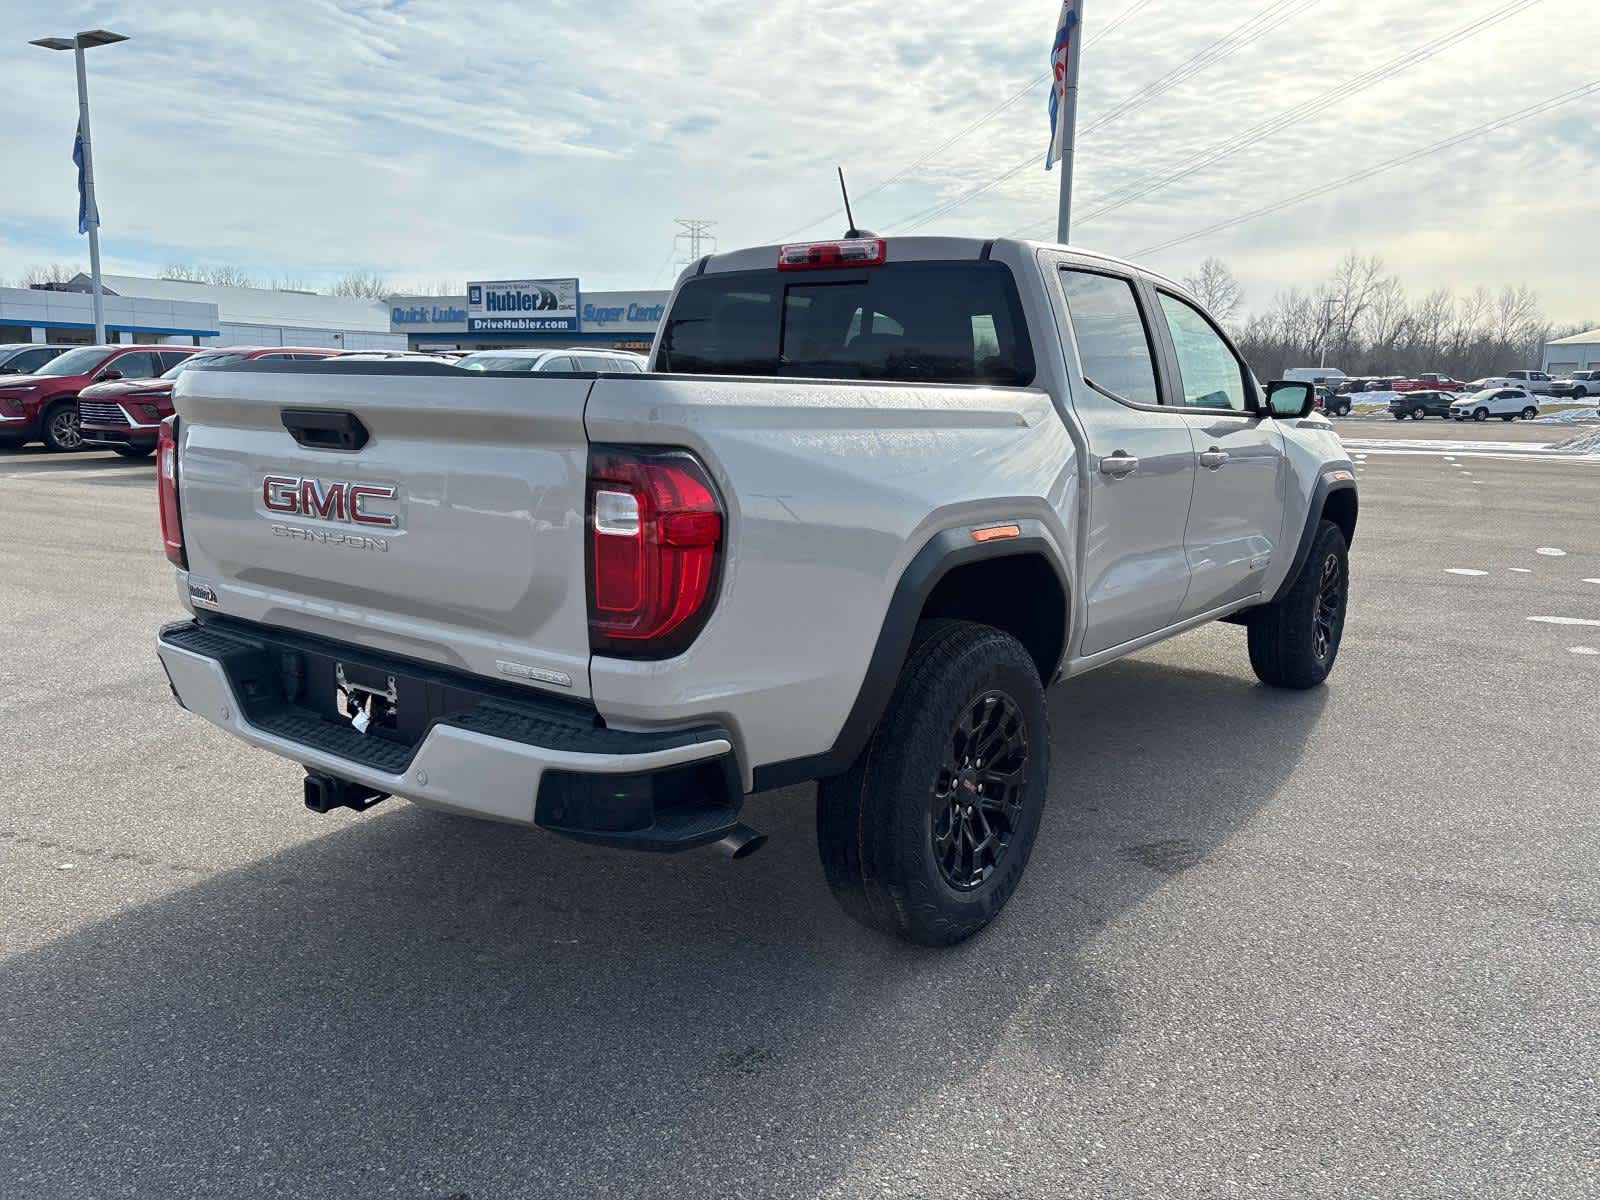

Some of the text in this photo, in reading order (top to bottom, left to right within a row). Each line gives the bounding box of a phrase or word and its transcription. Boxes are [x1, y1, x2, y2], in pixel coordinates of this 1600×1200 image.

[486, 291, 540, 312] Hubler
[392, 307, 431, 323] Quick
[474, 319, 568, 329] DriveHubler.com
[583, 303, 625, 327] Super
[263, 474, 399, 529] GMC
[271, 524, 389, 553] CANYON
